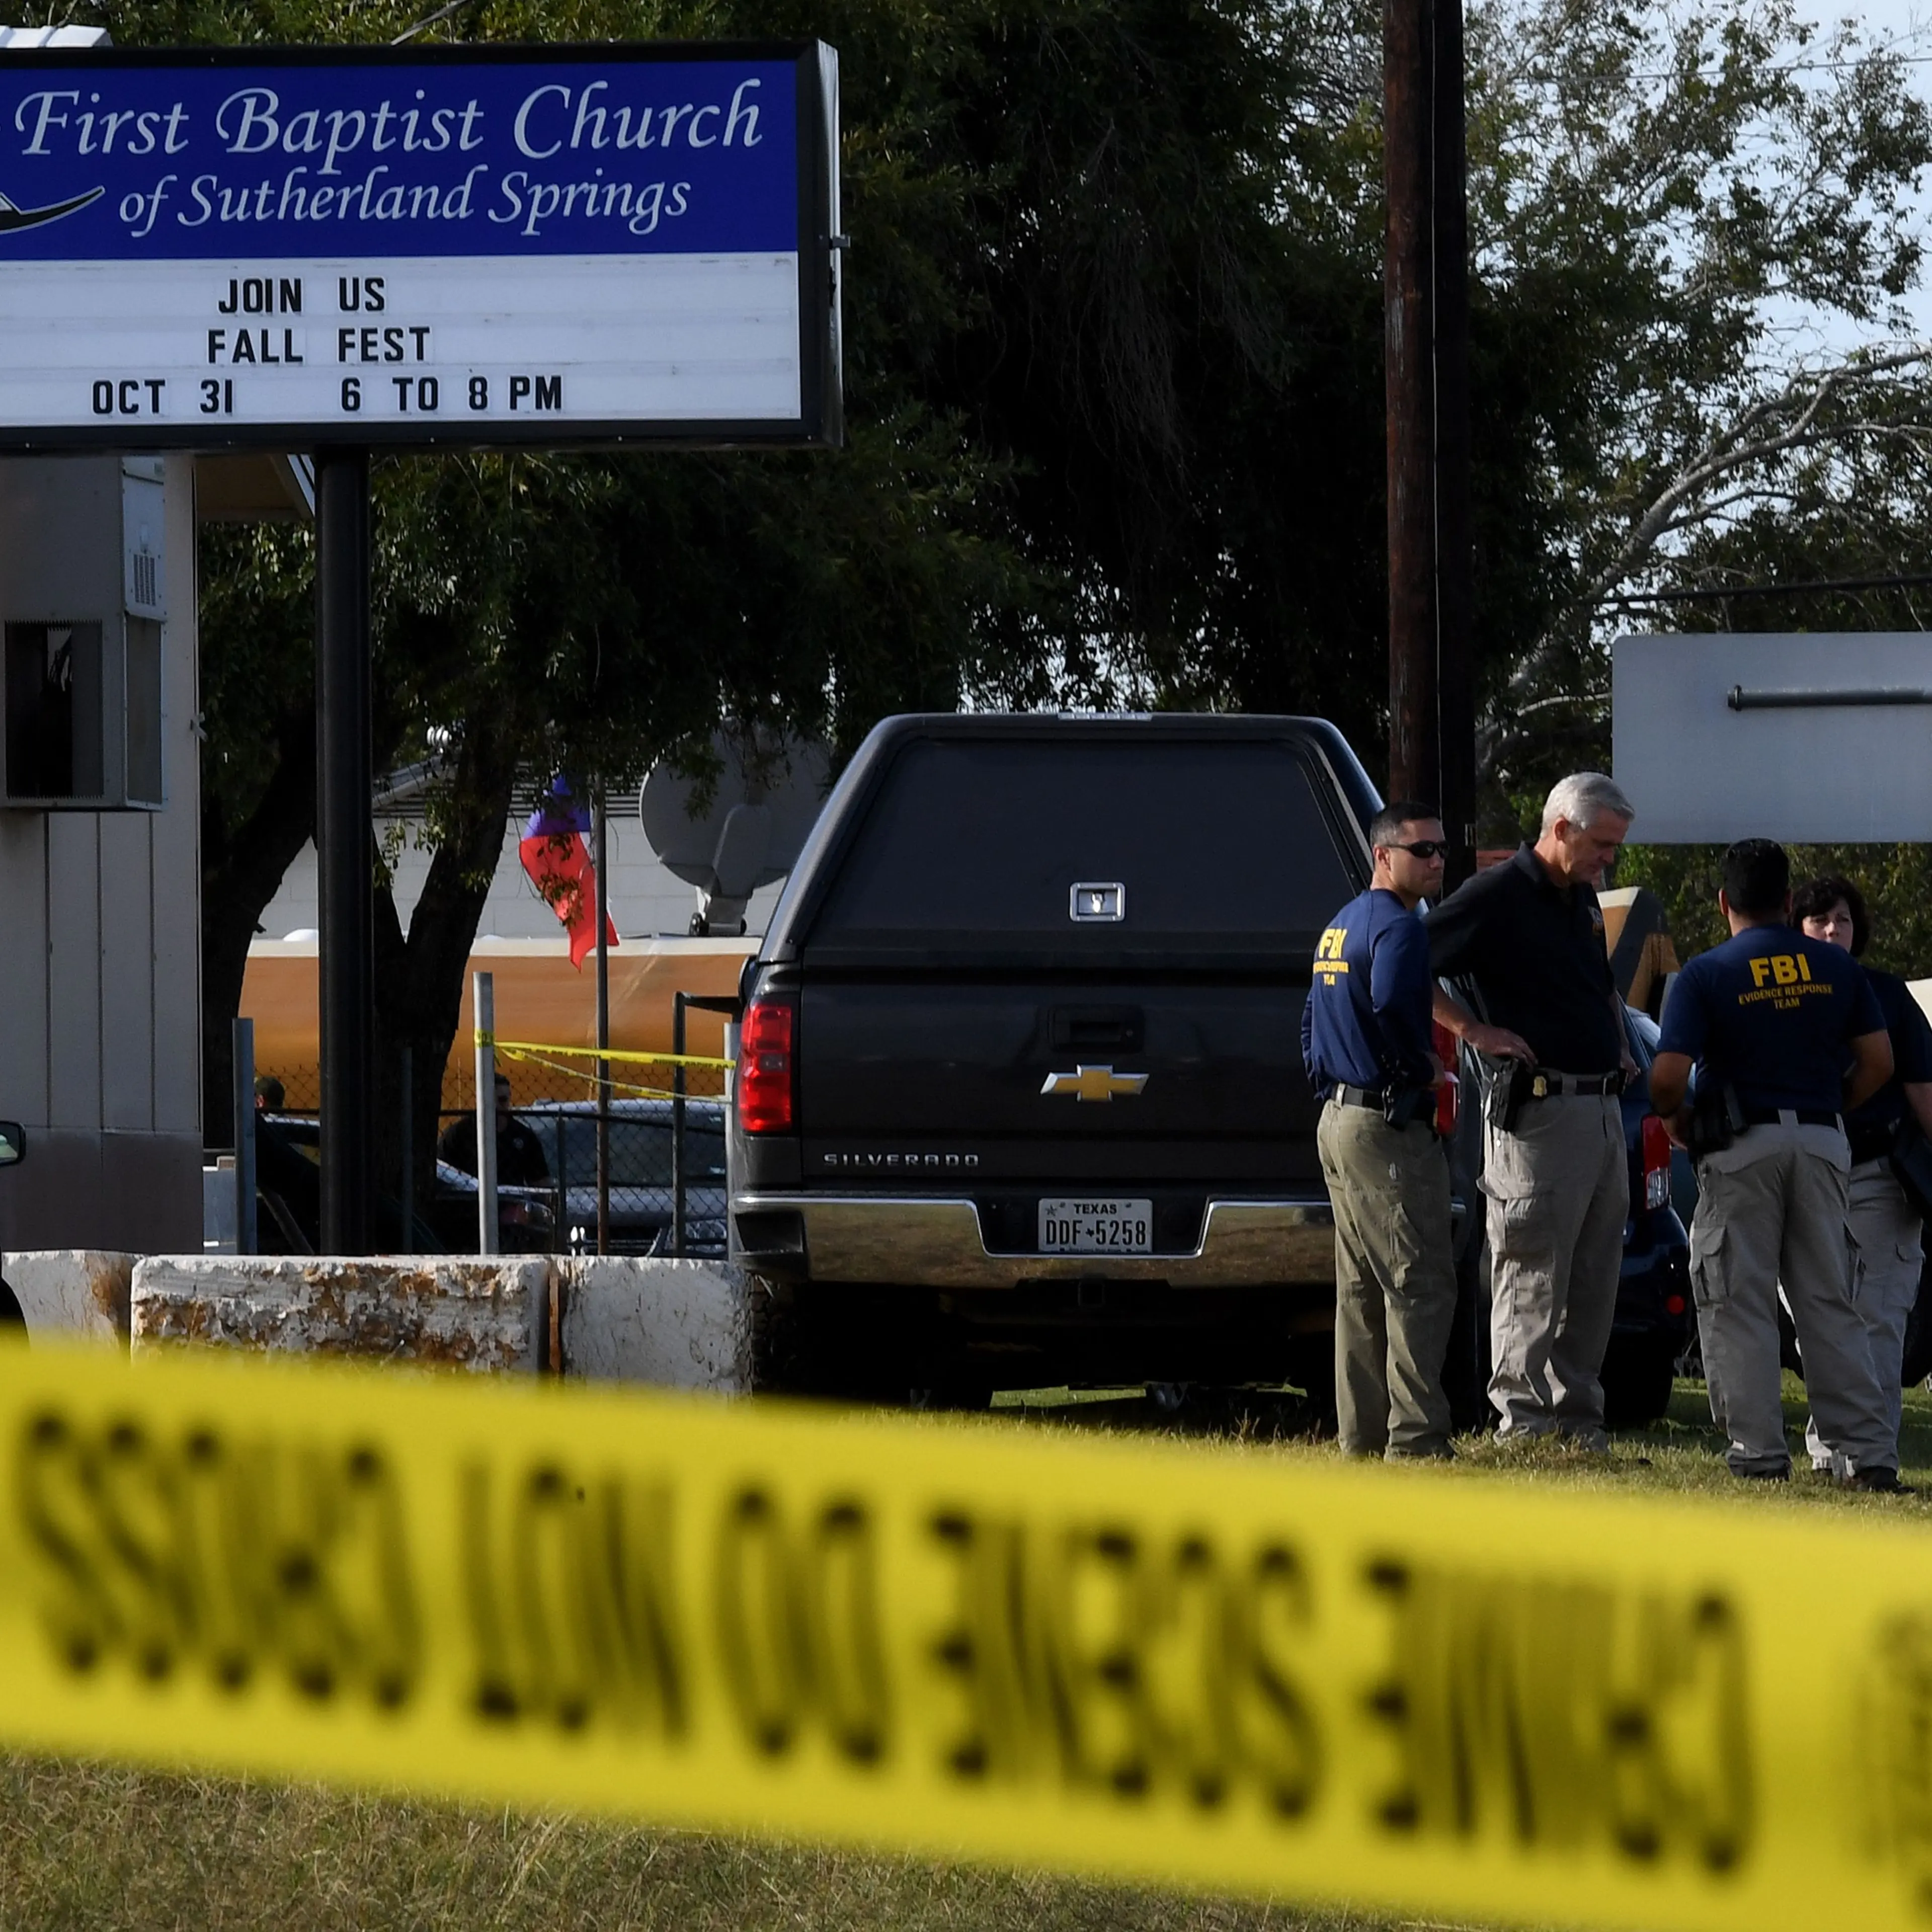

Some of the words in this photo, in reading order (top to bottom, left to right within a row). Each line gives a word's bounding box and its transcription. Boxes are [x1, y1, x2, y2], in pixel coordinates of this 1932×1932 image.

[15, 90, 190, 155] First
[216, 88, 485, 175] Baptist
[514, 78, 763, 159] Church
[119, 174, 178, 237] of
[177, 165, 489, 226] Sutherland
[487, 167, 692, 236] Springs
[218, 278, 302, 313] JOIN
[339, 277, 385, 312] US
[208, 329, 304, 364] FALL
[338, 327, 430, 362] FEST
[92, 379, 166, 414] OCT
[200, 379, 233, 414] 31
[341, 377, 361, 412] 6
[392, 377, 439, 412] TO
[468, 375, 488, 411] 8
[509, 375, 562, 410] PM
[1318, 928, 1348, 959] FBI
[1749, 953, 1812, 987] FBI
[1738, 986, 1783, 1005] EVIDENCE
[1785, 984, 1833, 996] RESPONSE
[1773, 997, 1800, 1009] TEAM
[824, 1153, 979, 1166] SILVERADO
[1073, 1203, 1117, 1215] TEXAS
[14, 1409, 423, 1711] CROSS
[458, 1446, 692, 1748] NOT
[714, 1482, 896, 1766] DO
[928, 1509, 1326, 1824] SCENE
[1361, 1555, 1756, 1879] CRIME
